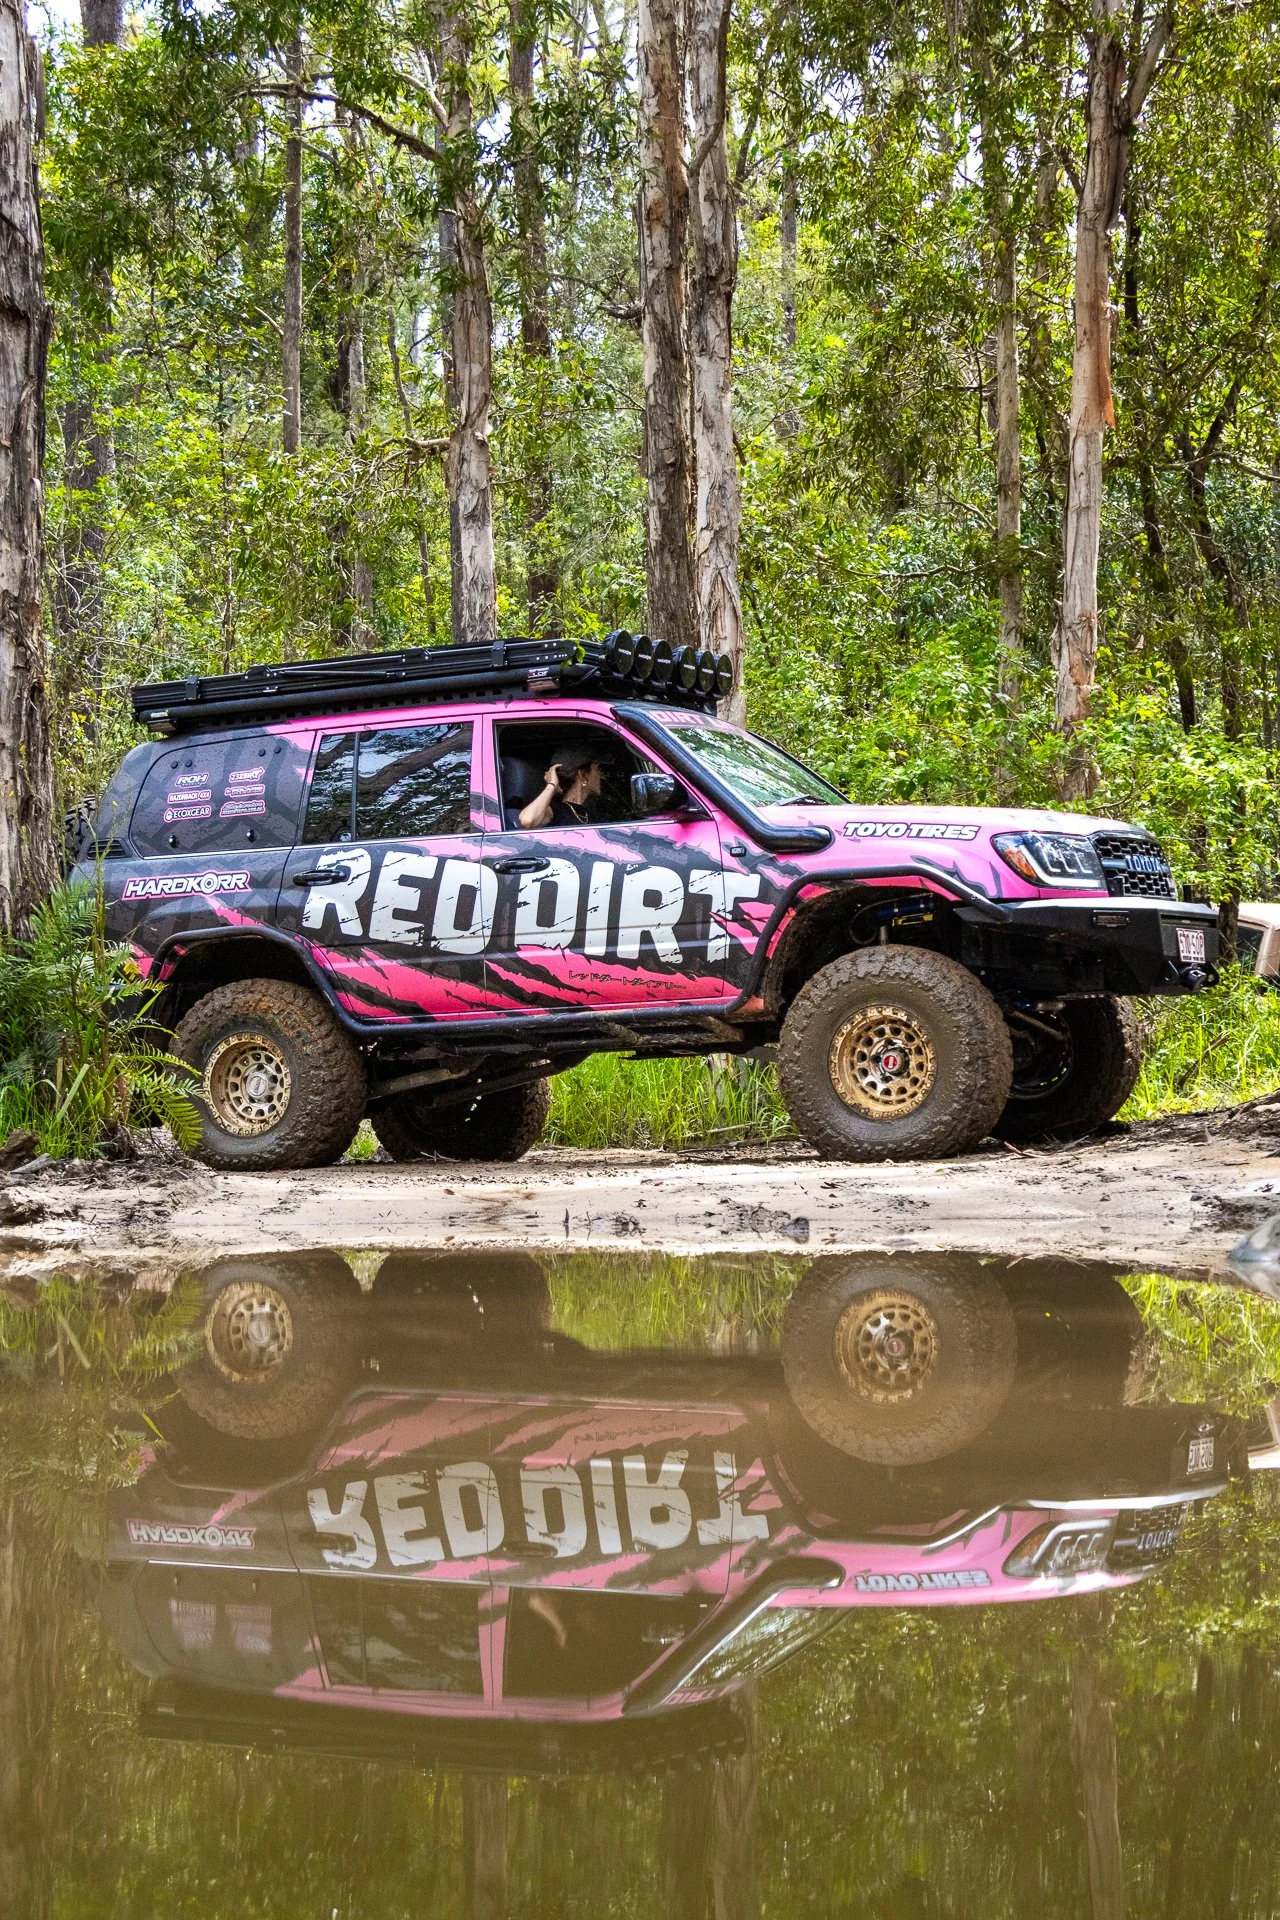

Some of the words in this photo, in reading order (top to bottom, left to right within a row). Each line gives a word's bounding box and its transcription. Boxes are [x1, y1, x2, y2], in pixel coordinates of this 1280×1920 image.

[649, 711, 705, 724] DIRT
[177, 774, 208, 785] ROH
[169, 792, 198, 802] RAZORBACK
[174, 807, 210, 819] ECOXGEAR
[843, 822, 909, 838] TOYO
[907, 823, 982, 841] TIRES
[125, 873, 248, 897] HARDKORR
[302, 847, 498, 955] RED
[515, 857, 761, 964] DIRT
